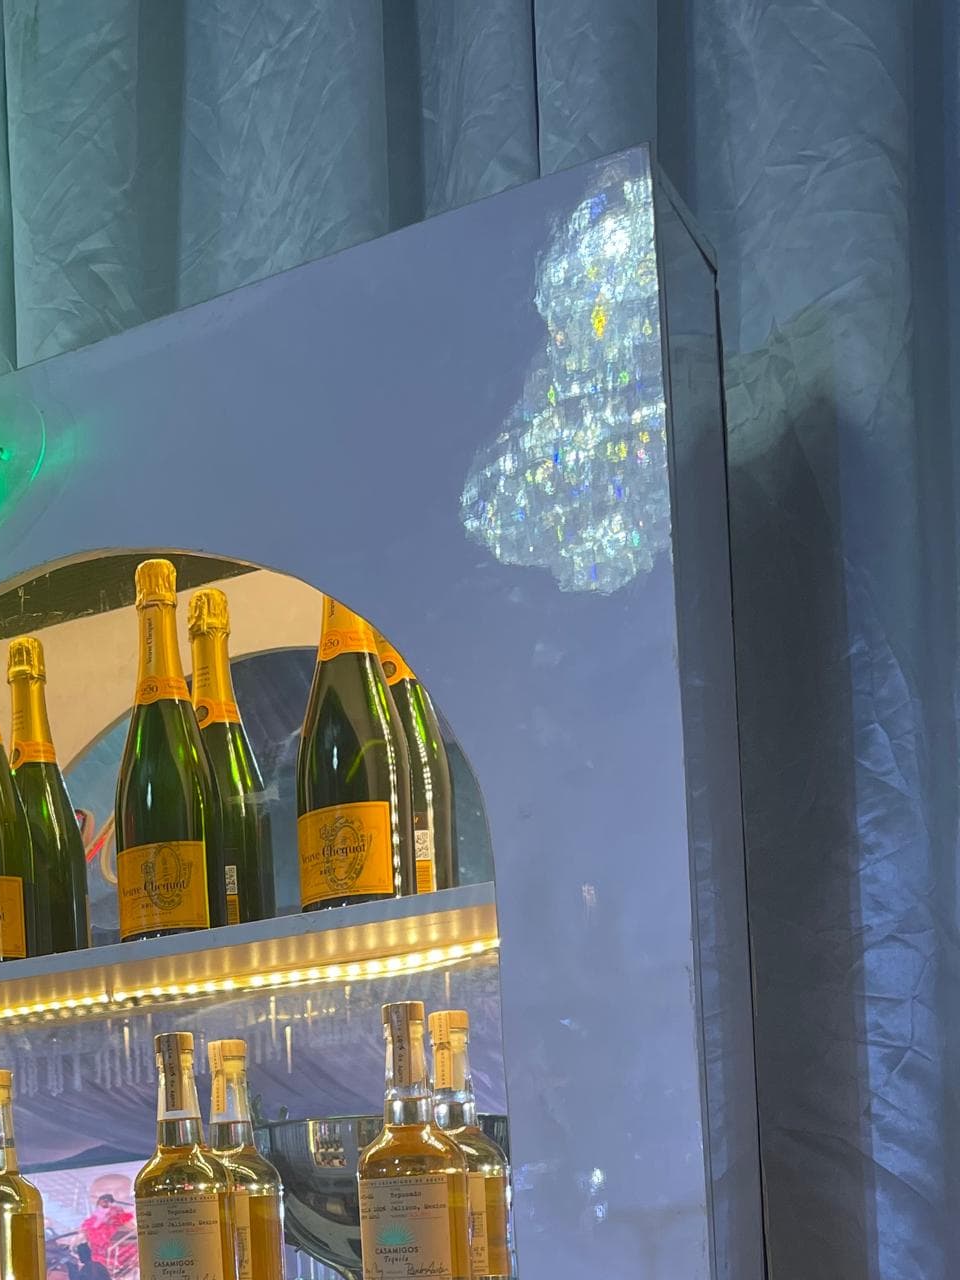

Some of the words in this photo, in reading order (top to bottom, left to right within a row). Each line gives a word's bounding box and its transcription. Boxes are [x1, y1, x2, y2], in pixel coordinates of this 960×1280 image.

[375, 1246, 419, 1256] CASAMIGOS
[153, 1259, 194, 1269] CASAMIGOS
[383, 1255, 409, 1264] Tequila
